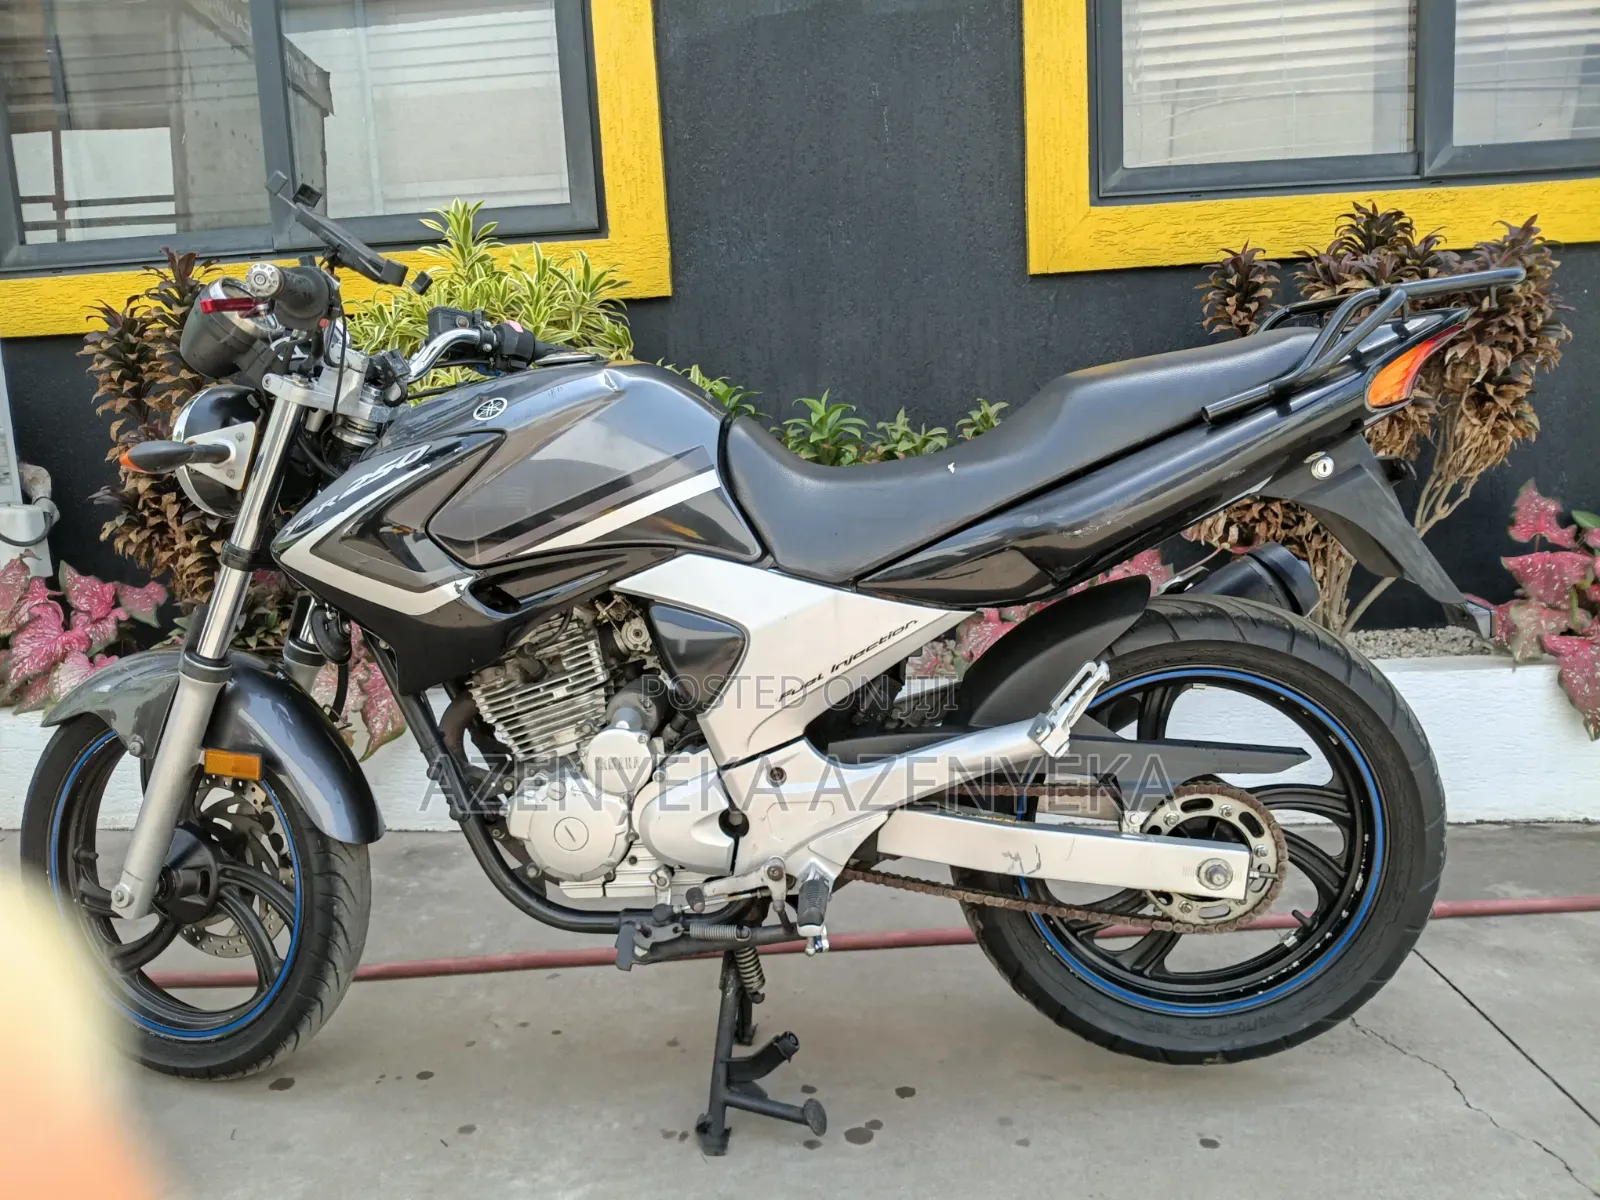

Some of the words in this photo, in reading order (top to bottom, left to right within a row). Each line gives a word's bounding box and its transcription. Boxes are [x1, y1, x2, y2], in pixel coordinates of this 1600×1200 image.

[337, 444, 432, 501] 250
[777, 672, 825, 702] Fuel
[830, 619, 918, 675] Injection
